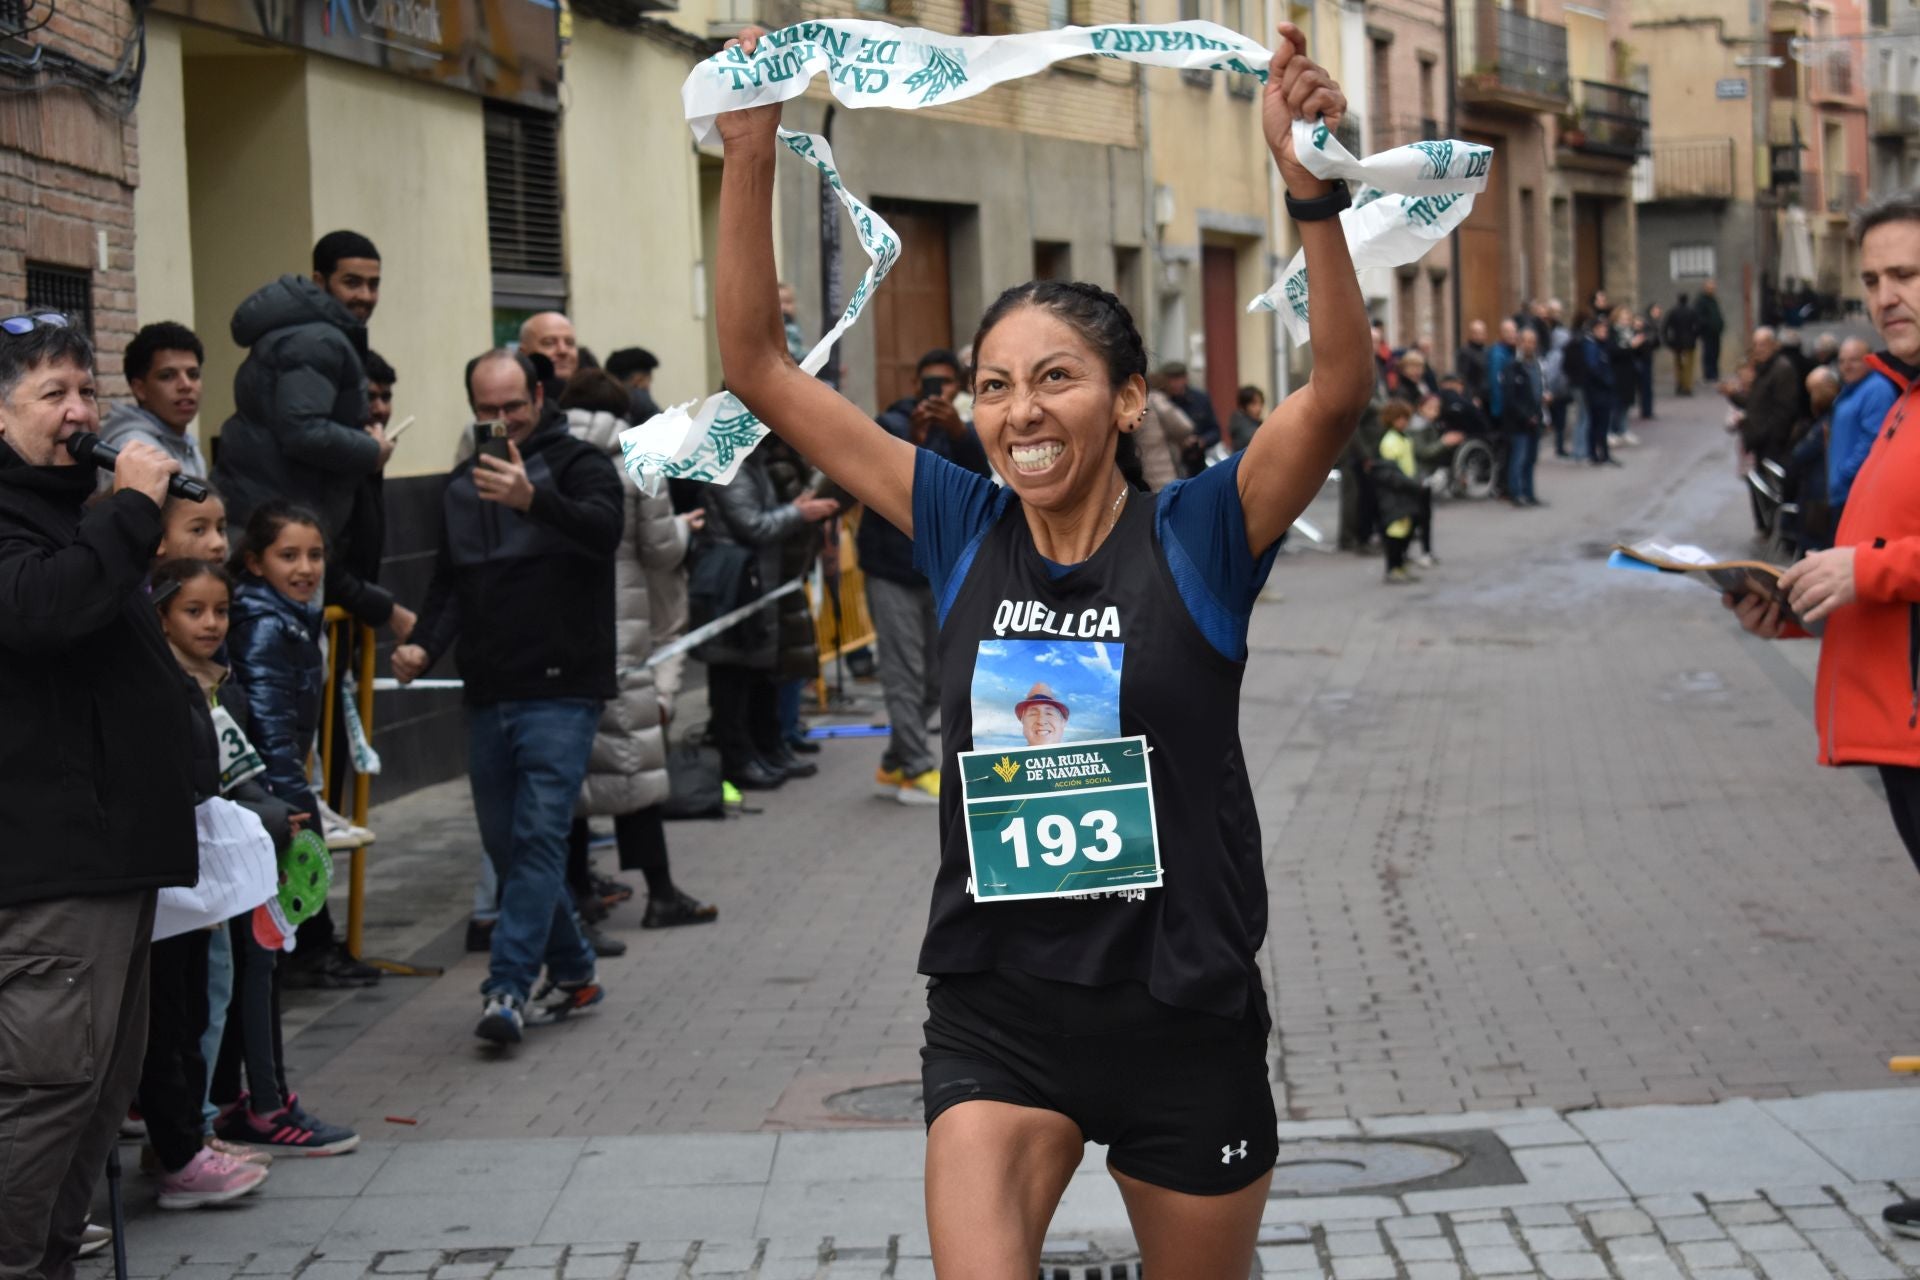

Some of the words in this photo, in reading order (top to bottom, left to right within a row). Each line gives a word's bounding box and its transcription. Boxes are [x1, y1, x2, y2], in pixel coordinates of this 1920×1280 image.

[856, 38, 901, 65] DE
[1091, 28, 1241, 52] VARRA
[718, 44, 817, 91] RURAL
[1464, 151, 1493, 178] DE
[1407, 192, 1464, 225] RAL
[992, 600, 1121, 638] QUELLCA
[1025, 756, 1056, 770] CAJA
[1058, 752, 1103, 767] RURAL
[1026, 769, 1044, 782] DE
[1046, 763, 1112, 781] NAVARRA
[1054, 779, 1082, 788] ACCIÓN
[1085, 776, 1112, 786] SOCIAL
[1001, 810, 1123, 868] 193
